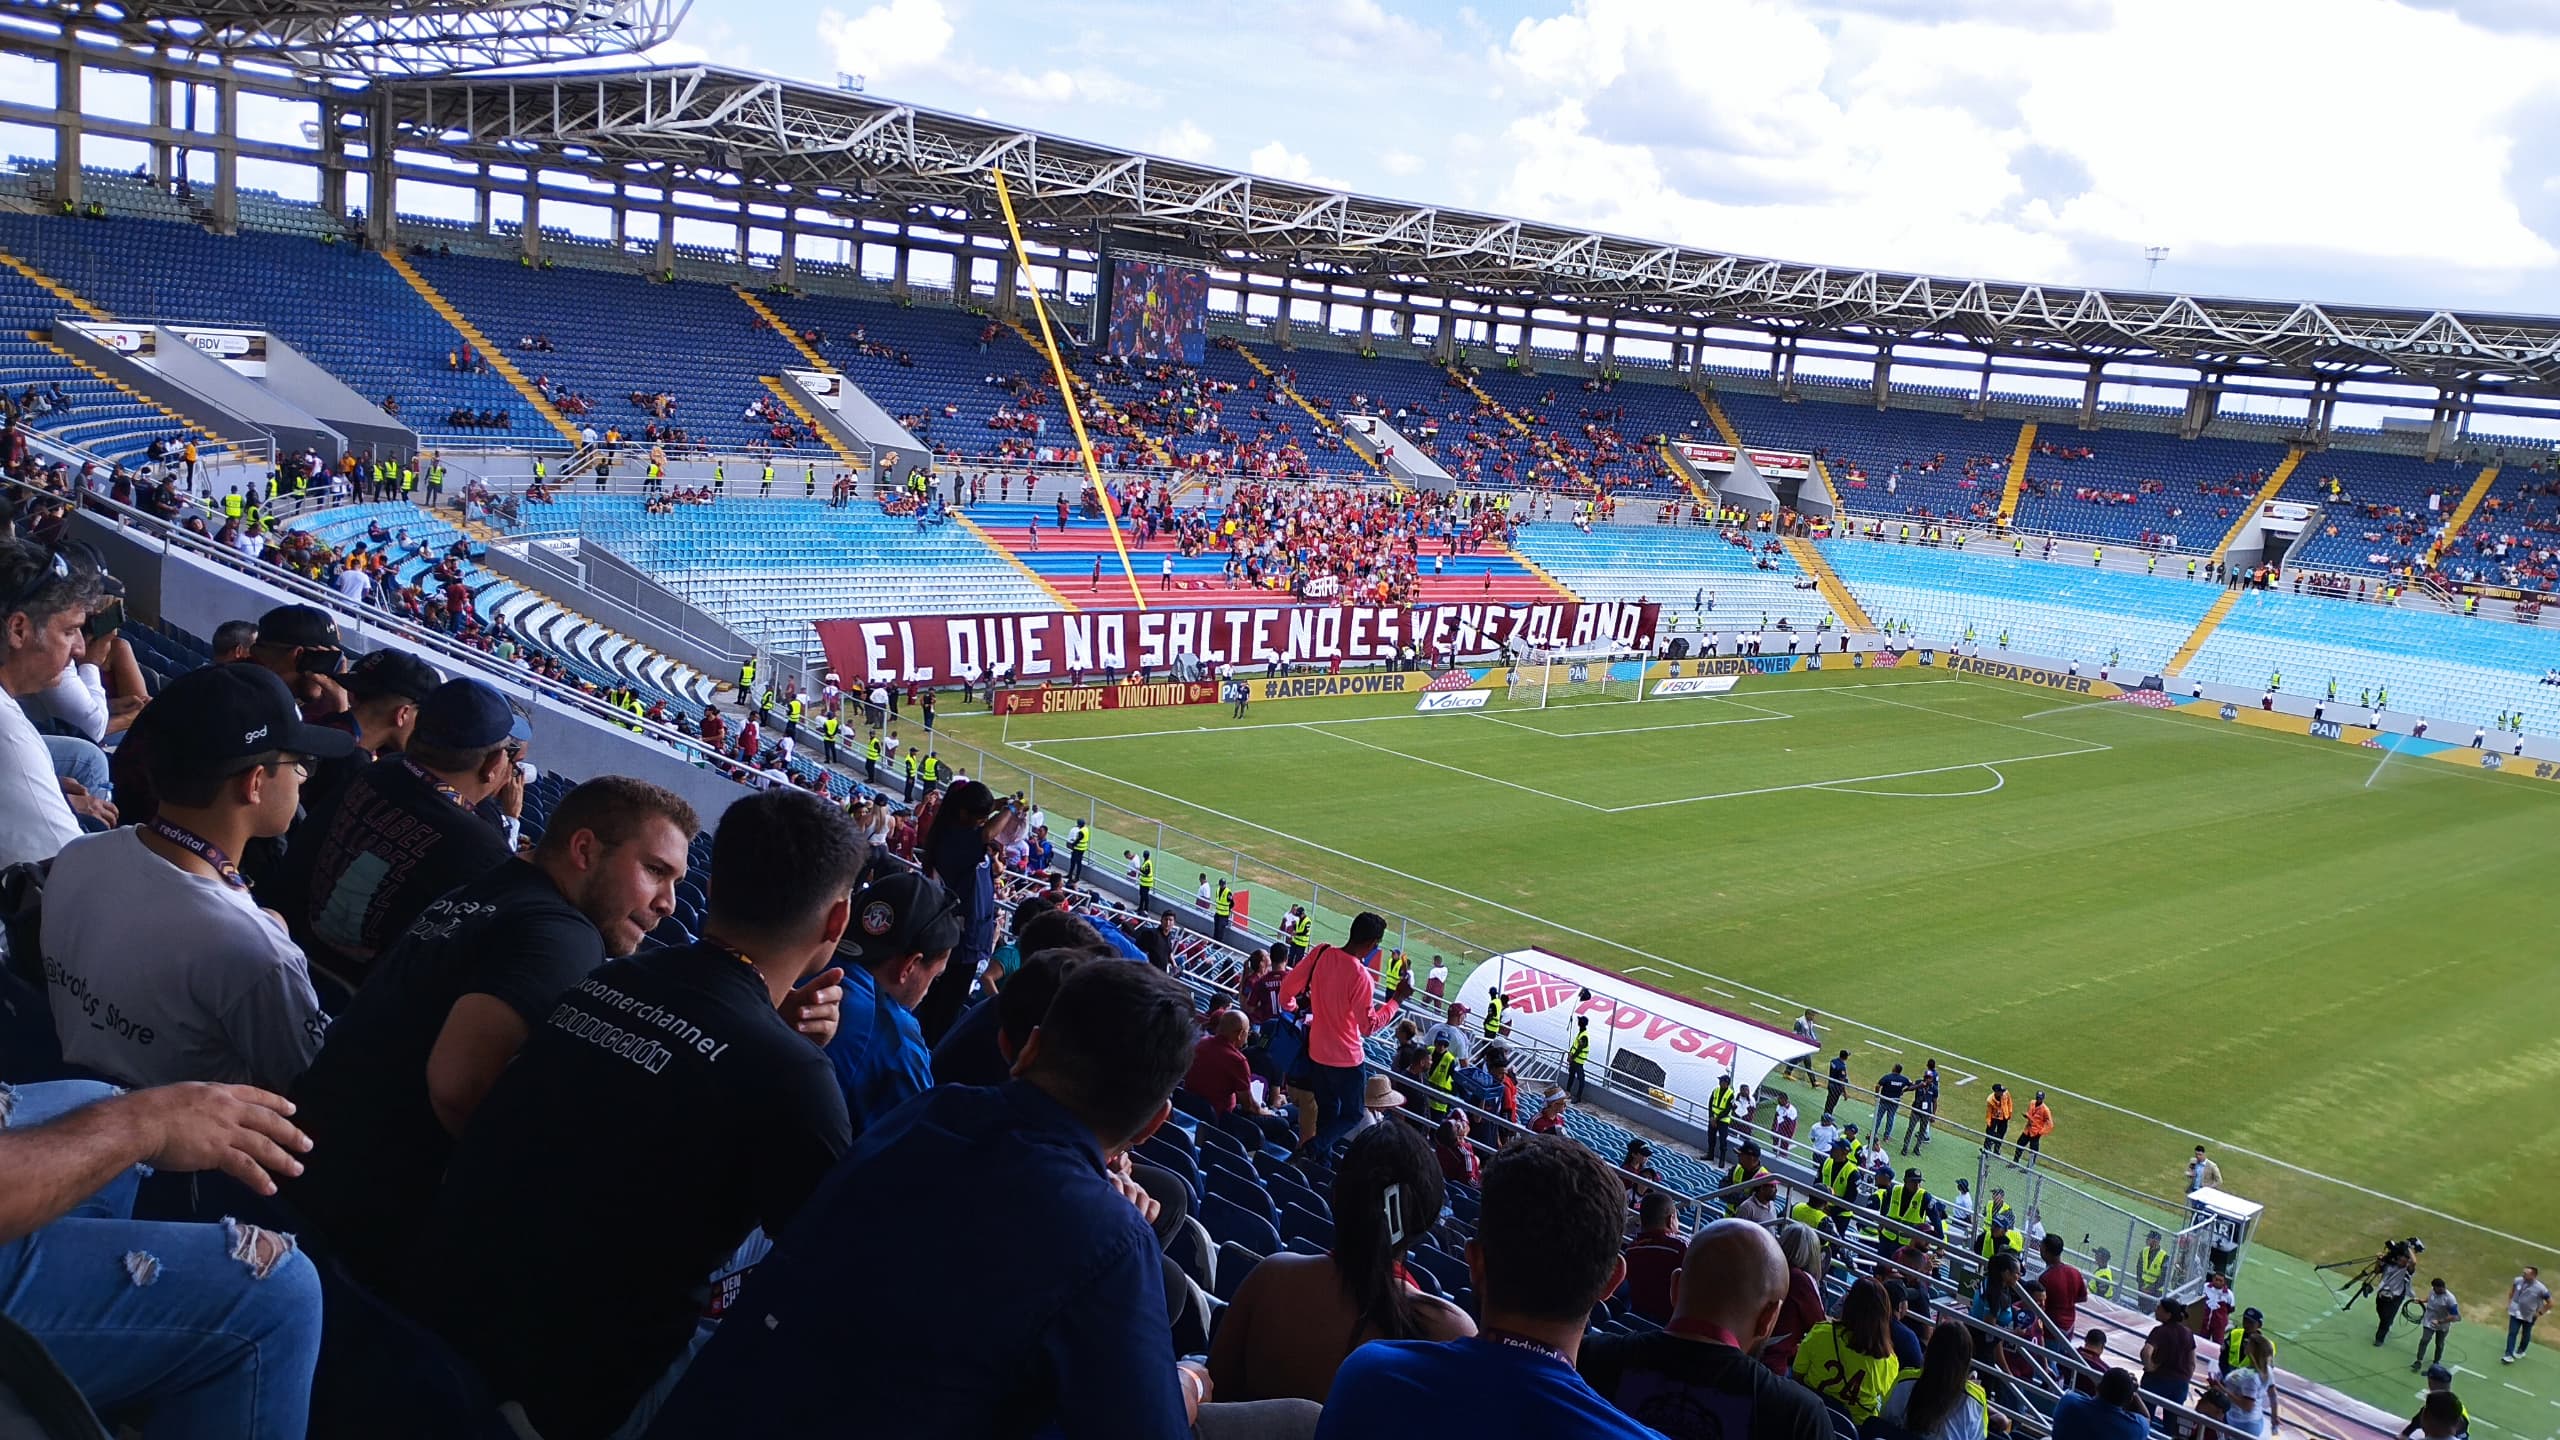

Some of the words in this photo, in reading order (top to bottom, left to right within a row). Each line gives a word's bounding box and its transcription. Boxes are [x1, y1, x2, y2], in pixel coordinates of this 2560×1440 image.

[199, 338, 220, 349] BDV
[859, 621, 933, 684] EL
[947, 616, 1051, 681] QUE
[1063, 614, 1126, 671] NO
[1139, 609, 1279, 666] SALTE
[1289, 607, 1341, 660] NO
[1350, 607, 1399, 657] ES
[1697, 657, 1791, 676] #AREPAPOWER
[1806, 655, 1822, 668] PAN
[1918, 651, 1934, 665] PAN
[1568, 666, 1589, 681] PAN
[1947, 655, 2092, 693] #AREPAPOWER
[1222, 684, 1239, 700] PA
[1265, 674, 1406, 698] #AREPAPOWER
[1671, 680, 1704, 692] BDV
[1042, 689, 1104, 712] SIEMPRE
[1118, 684, 1186, 708] VINOTINTO
[1429, 694, 1483, 708] Valcro
[2220, 707, 2239, 718] PAN
[245, 724, 267, 744] god
[2309, 721, 2341, 738] PAN
[2481, 755, 2503, 768] PAN
[160, 824, 206, 852] redvital
[1575, 995, 1737, 1066] PDVSA
[722, 1273, 741, 1292] VEN
[722, 1288, 740, 1309] CH
[1817, 1359, 1866, 1406] 24
